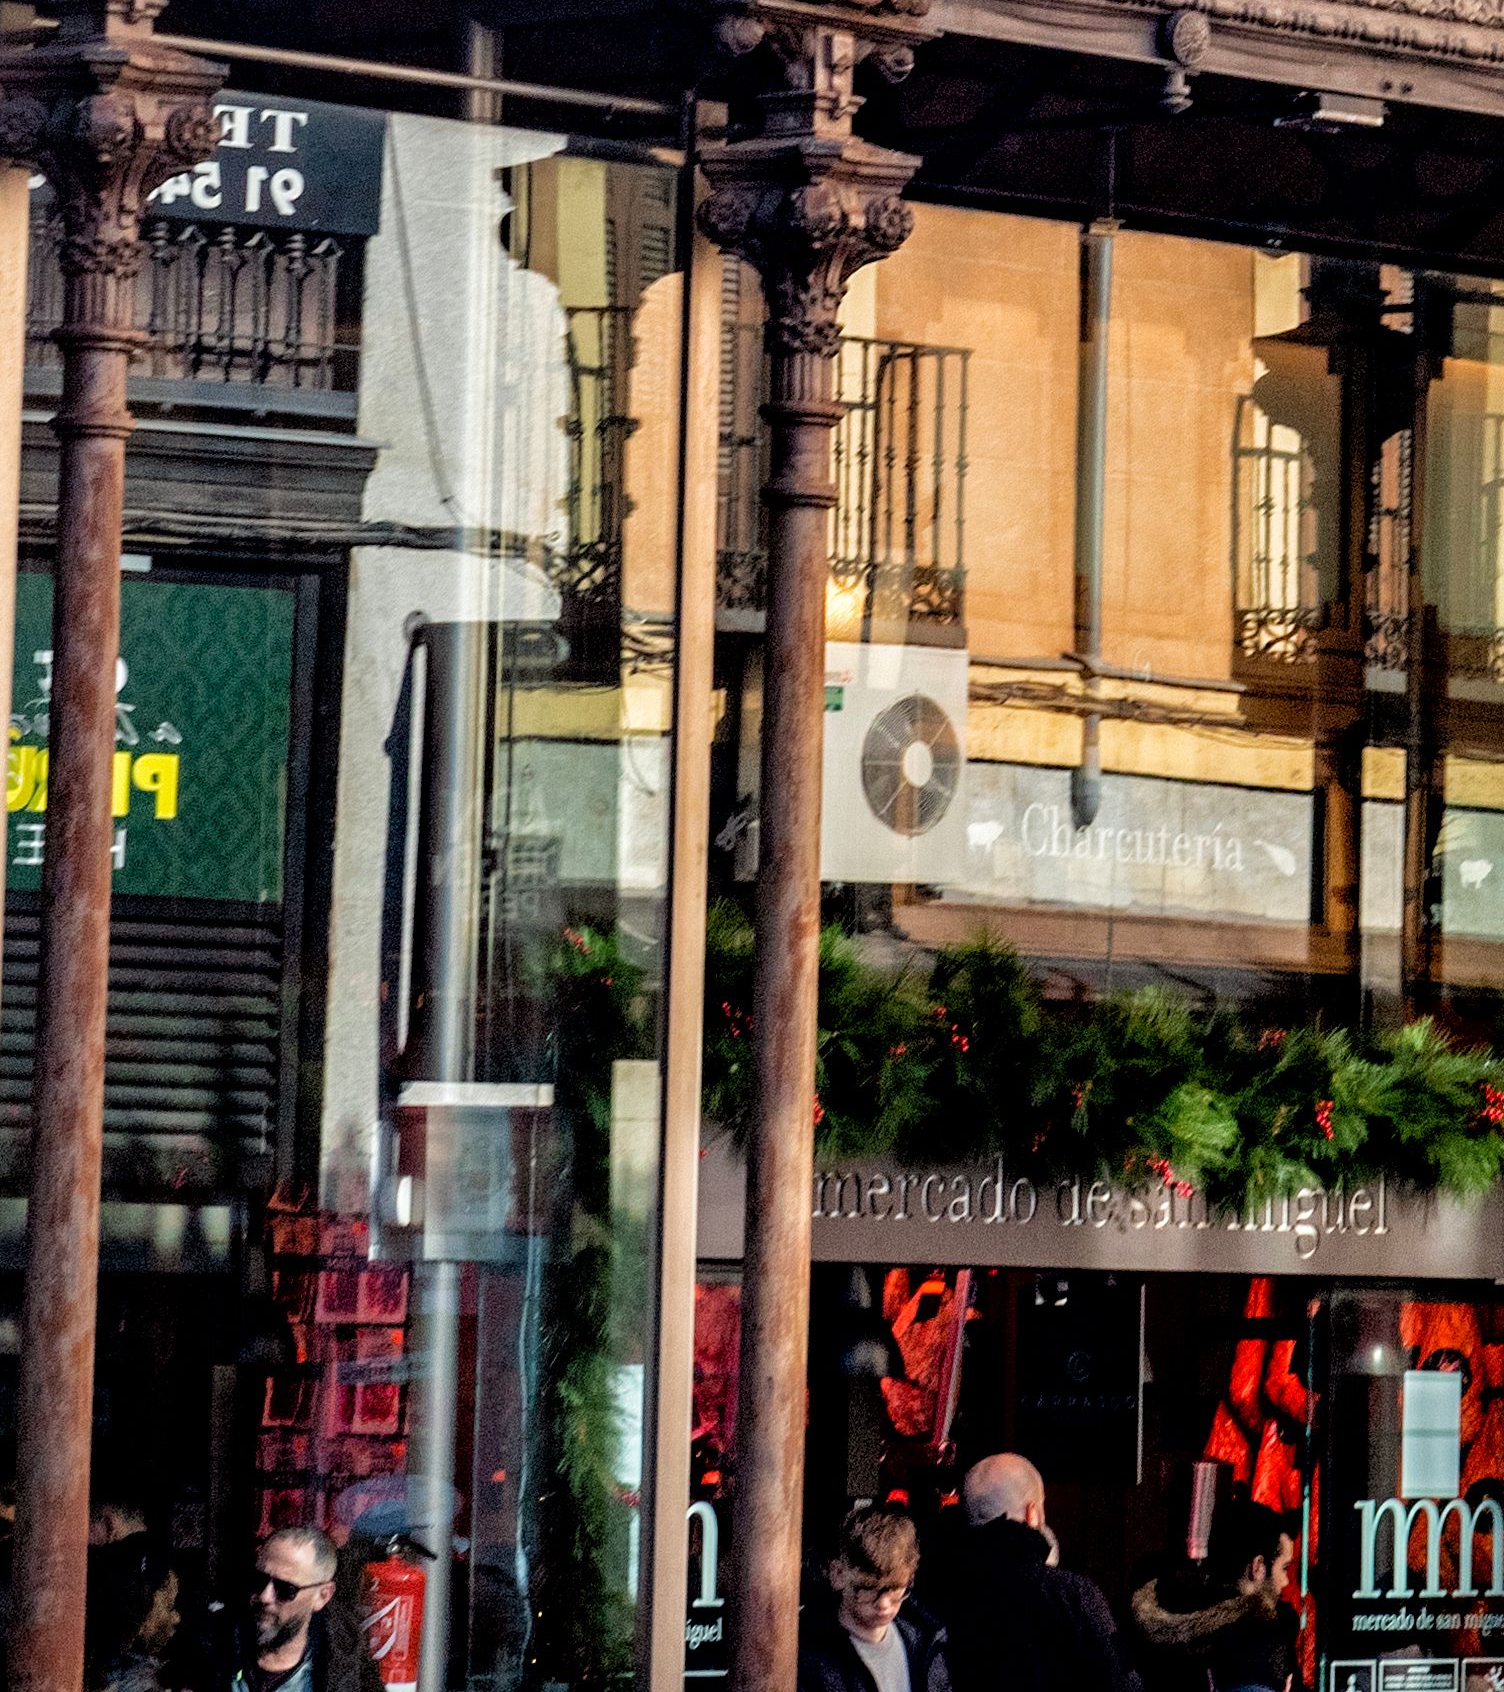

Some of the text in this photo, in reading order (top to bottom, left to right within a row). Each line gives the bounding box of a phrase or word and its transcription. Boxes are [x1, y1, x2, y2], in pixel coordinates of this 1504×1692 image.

[1021, 802, 1245, 872] Charcutería
[811, 1150, 1038, 1225] mercado
[1056, 1166, 1113, 1229] de
[685, 1617, 724, 1651] iguel
[1352, 1606, 1415, 1632] mercado
[1416, 1606, 1435, 1631] de
[1436, 1613, 1462, 1631] san
